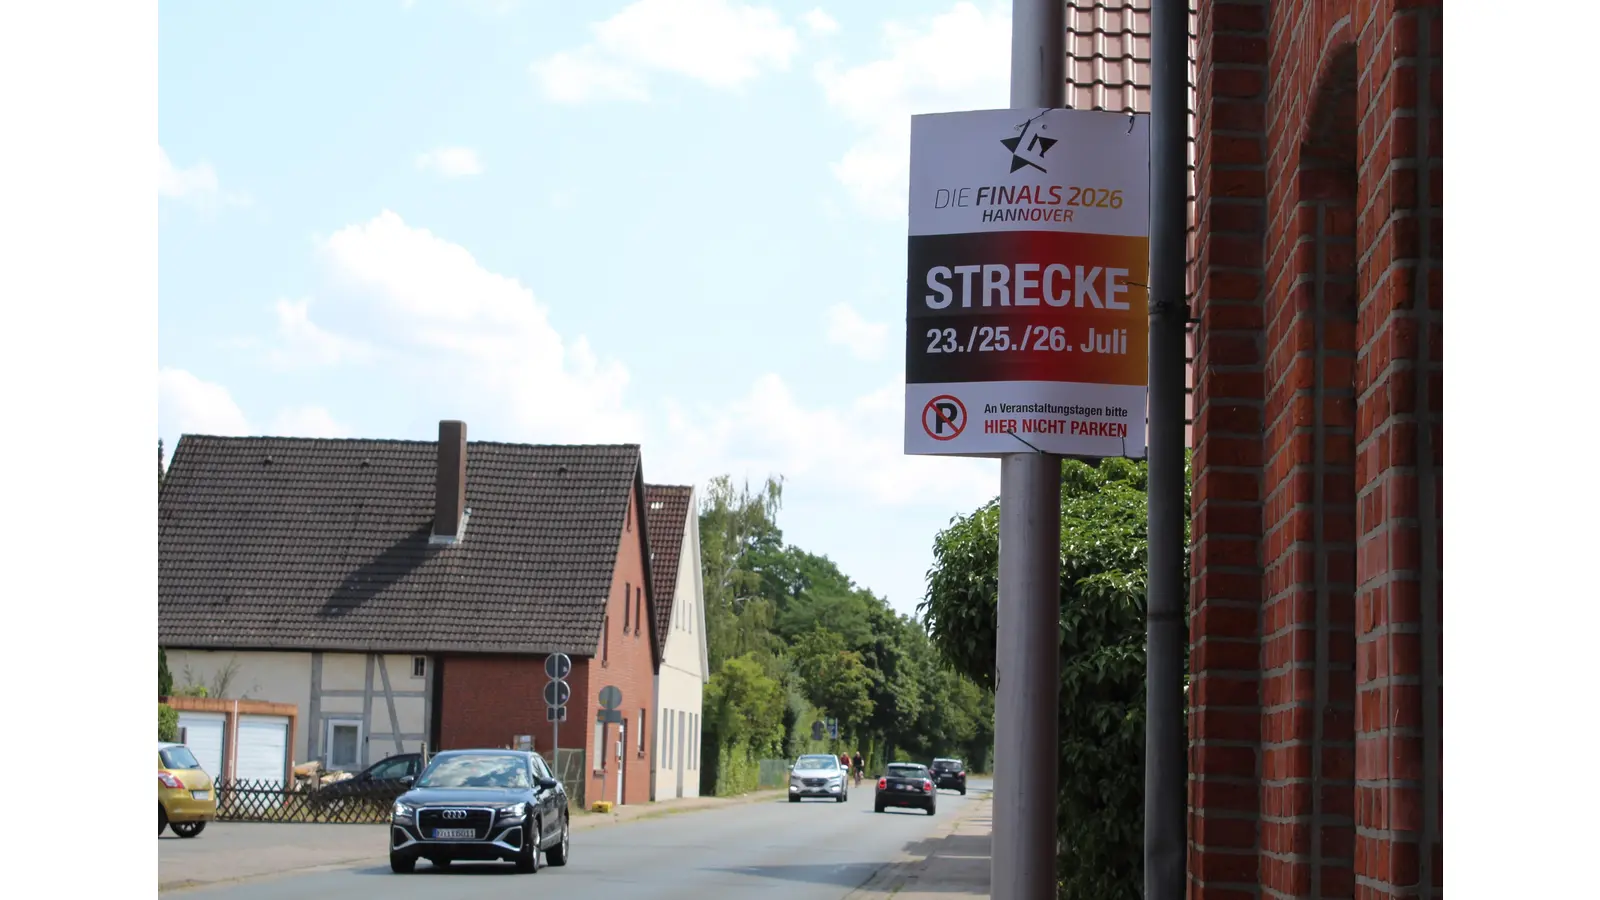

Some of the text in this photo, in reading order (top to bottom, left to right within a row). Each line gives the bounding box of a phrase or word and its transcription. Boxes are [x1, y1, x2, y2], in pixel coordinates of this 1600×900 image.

[935, 185, 1124, 209] DIE FINALS 2026
[982, 208, 1074, 223] HANNOVER
[925, 262, 1130, 311] STRECKE
[926, 325, 1127, 355] 23./25./26. Juli
[984, 403, 1128, 417] An Veranstaltungstagen bitte
[984, 419, 1127, 437] HIER NICHT PARKEN
